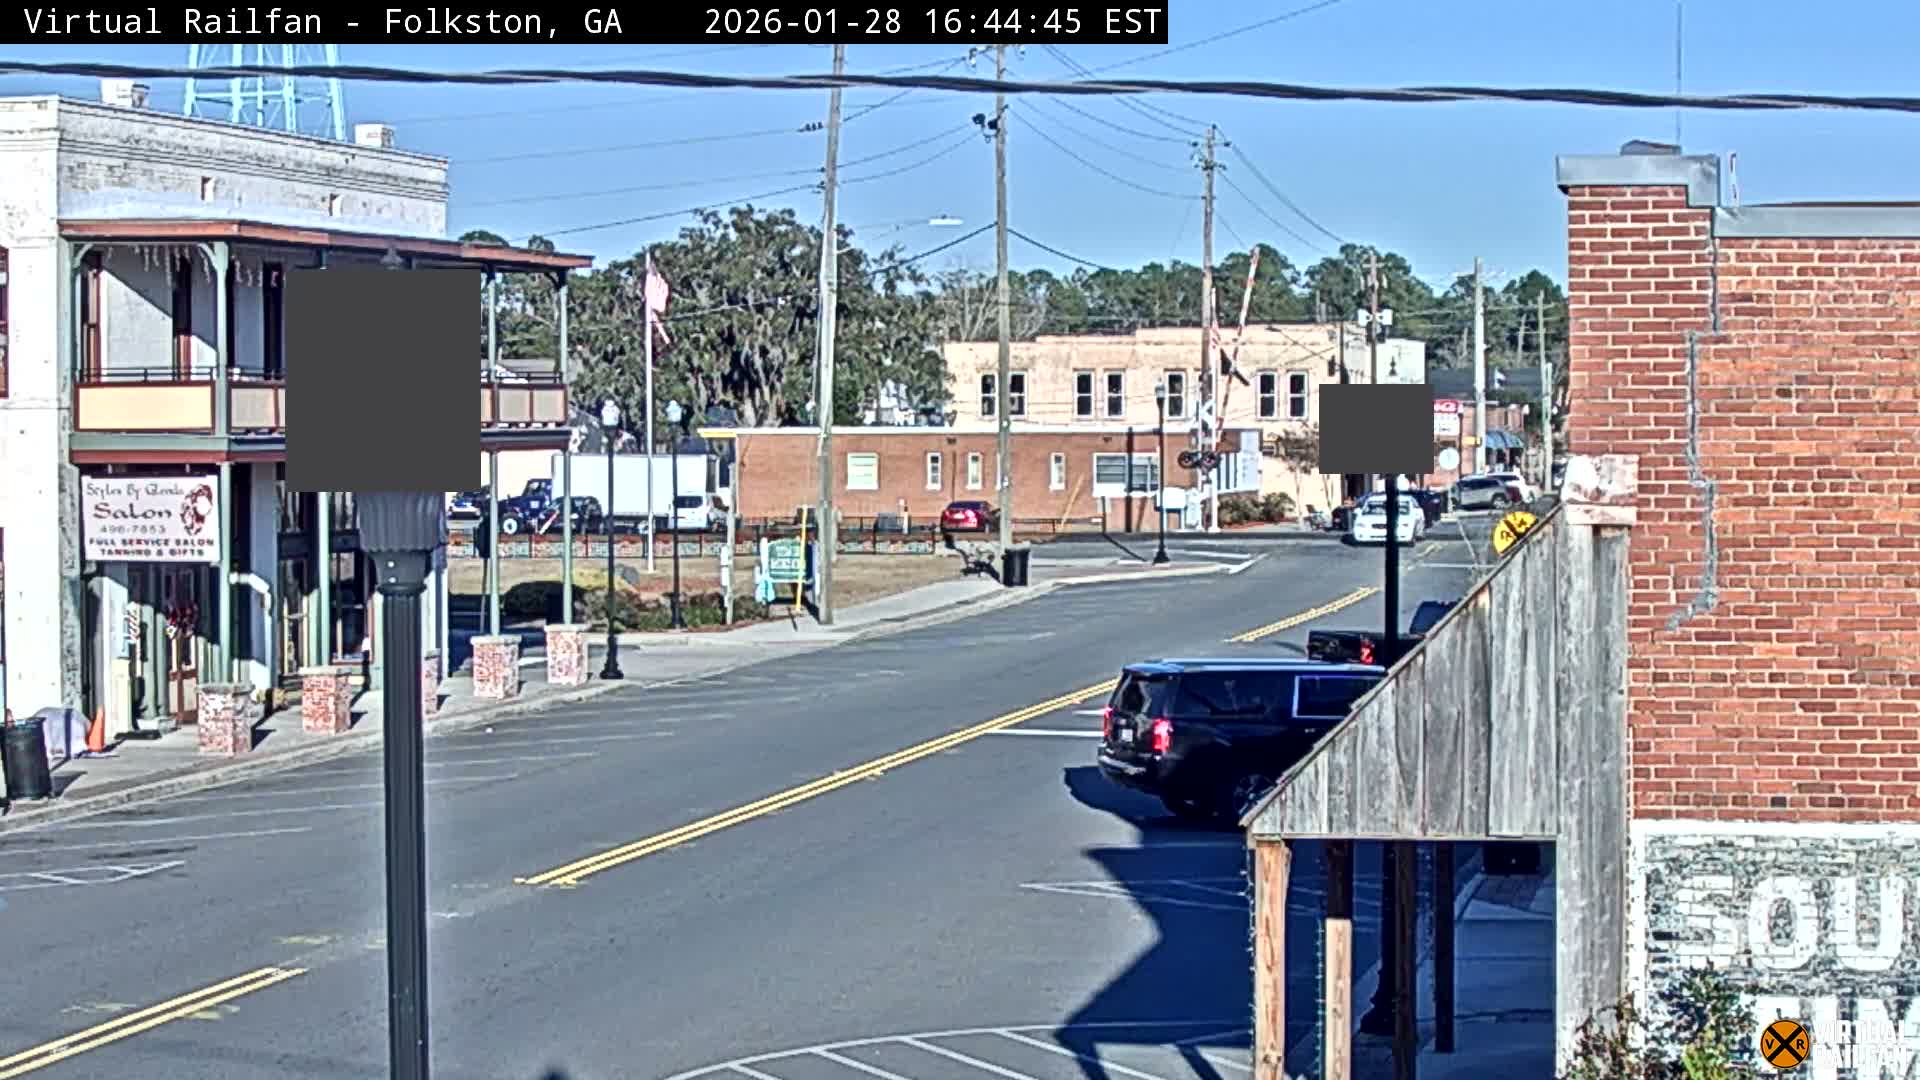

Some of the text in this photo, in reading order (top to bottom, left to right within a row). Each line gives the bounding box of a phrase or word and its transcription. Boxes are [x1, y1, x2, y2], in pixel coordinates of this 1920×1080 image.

[127, 483, 139, 500] By
[93, 502, 172, 519] Salon
[89, 538, 214, 546] FULL SERVICE SALON
[100, 549, 151, 557] TANNING
[168, 549, 204, 557] GIFTS
